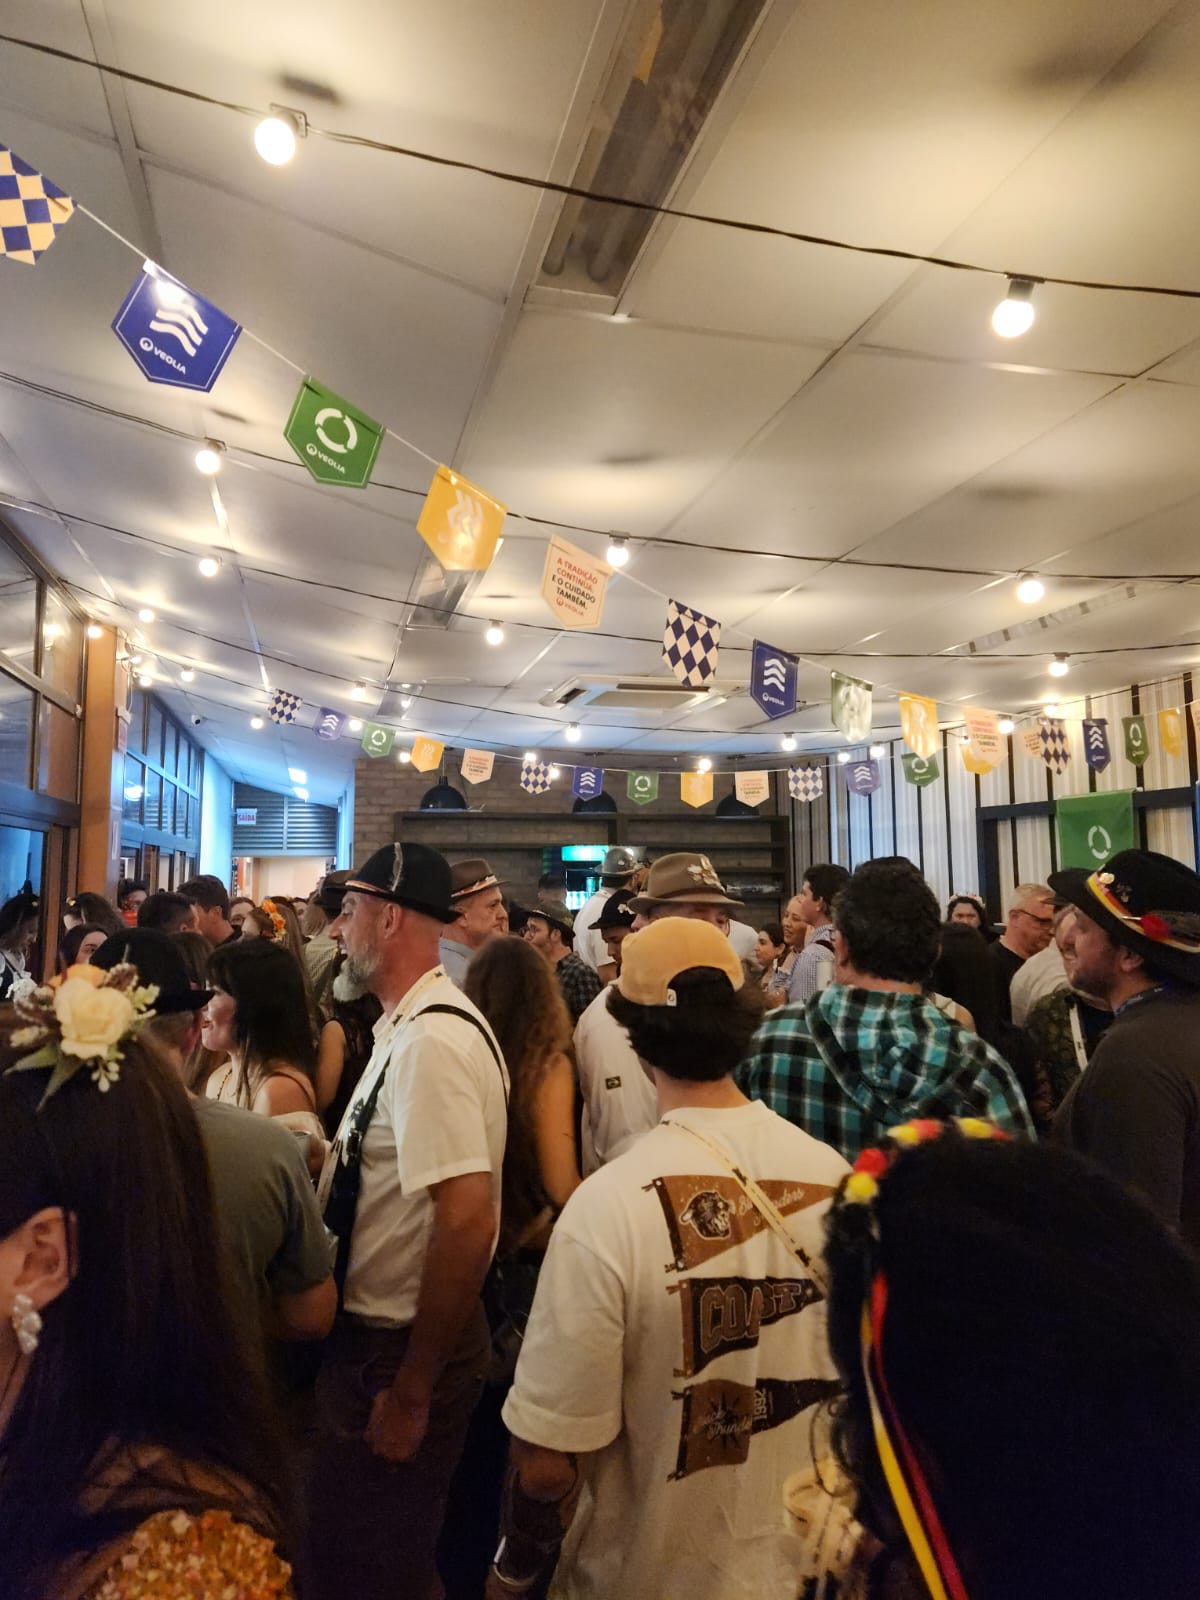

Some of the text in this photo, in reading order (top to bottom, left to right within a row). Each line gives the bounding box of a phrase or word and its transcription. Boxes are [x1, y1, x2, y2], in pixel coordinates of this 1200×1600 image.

[154, 347, 186, 374] VEOLIA
[318, 450, 346, 474] VEOLIA
[557, 557, 598, 585] A TRADIÇÃO
[552, 574, 556, 582] E
[564, 582, 596, 603] CUIDADO
[753, 1388, 768, 1420] 1992
